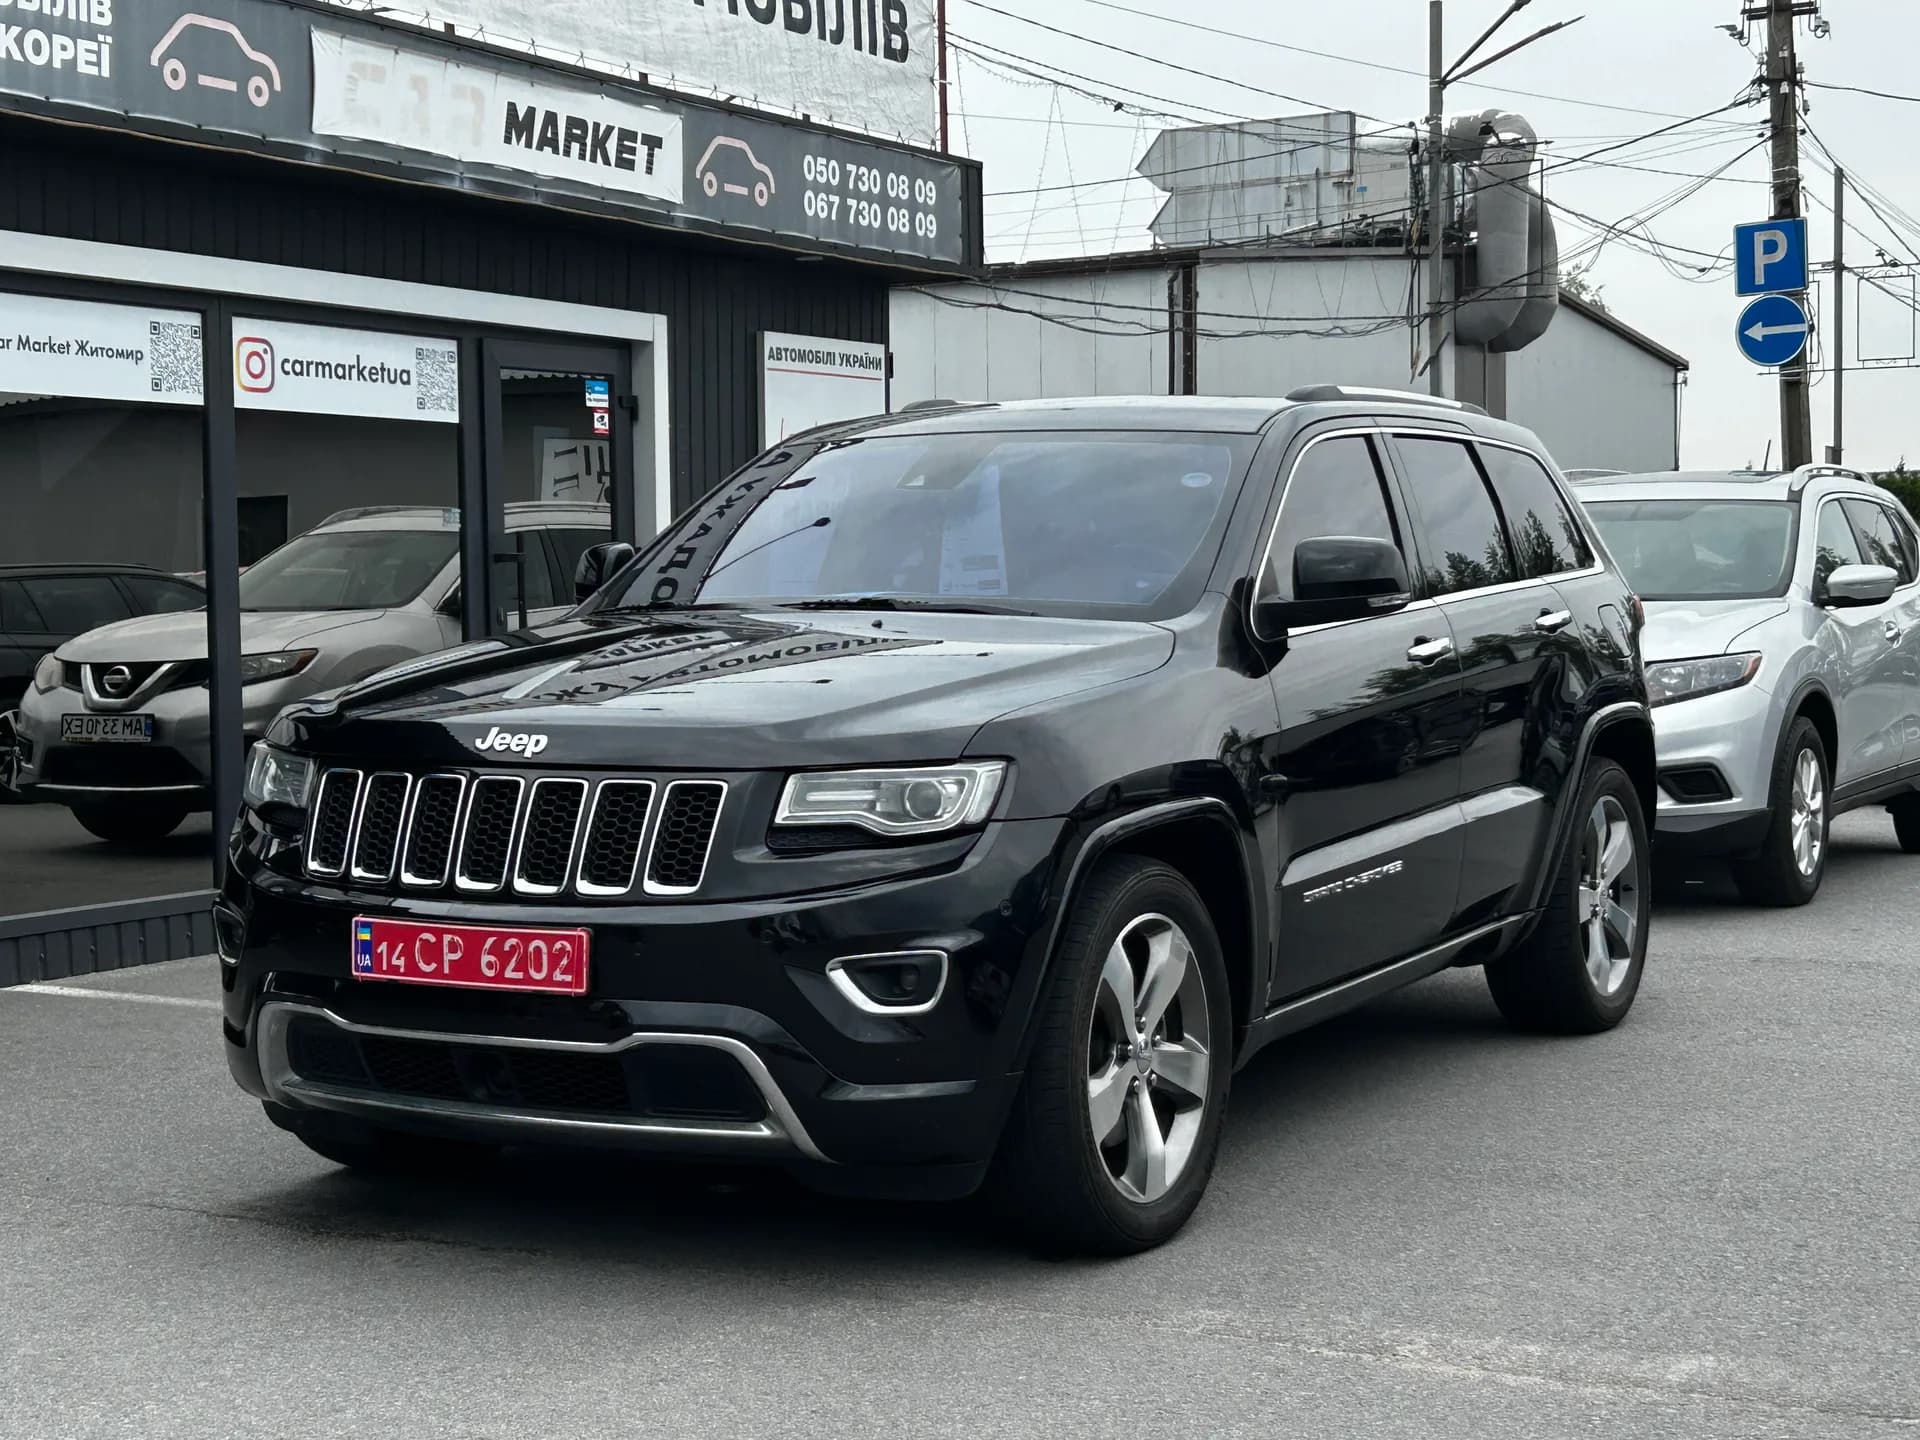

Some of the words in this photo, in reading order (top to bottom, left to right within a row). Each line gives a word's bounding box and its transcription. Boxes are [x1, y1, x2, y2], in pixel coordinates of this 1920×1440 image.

[503, 101, 663, 175] MARKET
[803, 155, 840, 186] 050
[846, 163, 881, 194] 730
[886, 172, 909, 200] 08
[915, 178, 936, 206] 09
[803, 189, 840, 221] 067
[846, 198, 881, 229] 730
[887, 206, 910, 233] 08
[915, 212, 937, 239] 09
[1754, 229, 1788, 285] P
[16, 334, 71, 355] Market
[74, 339, 144, 366] Житомир
[280, 354, 411, 386] carmarketua
[768, 346, 836, 366] АВТОМОБІЛІ
[838, 351, 882, 372] УКРАЇНИ
[475, 727, 549, 758] Jeep
[357, 953, 372, 967] UA
[376, 941, 405, 973] 14
[415, 932, 464, 974] CP
[480, 937, 573, 982] 6202
